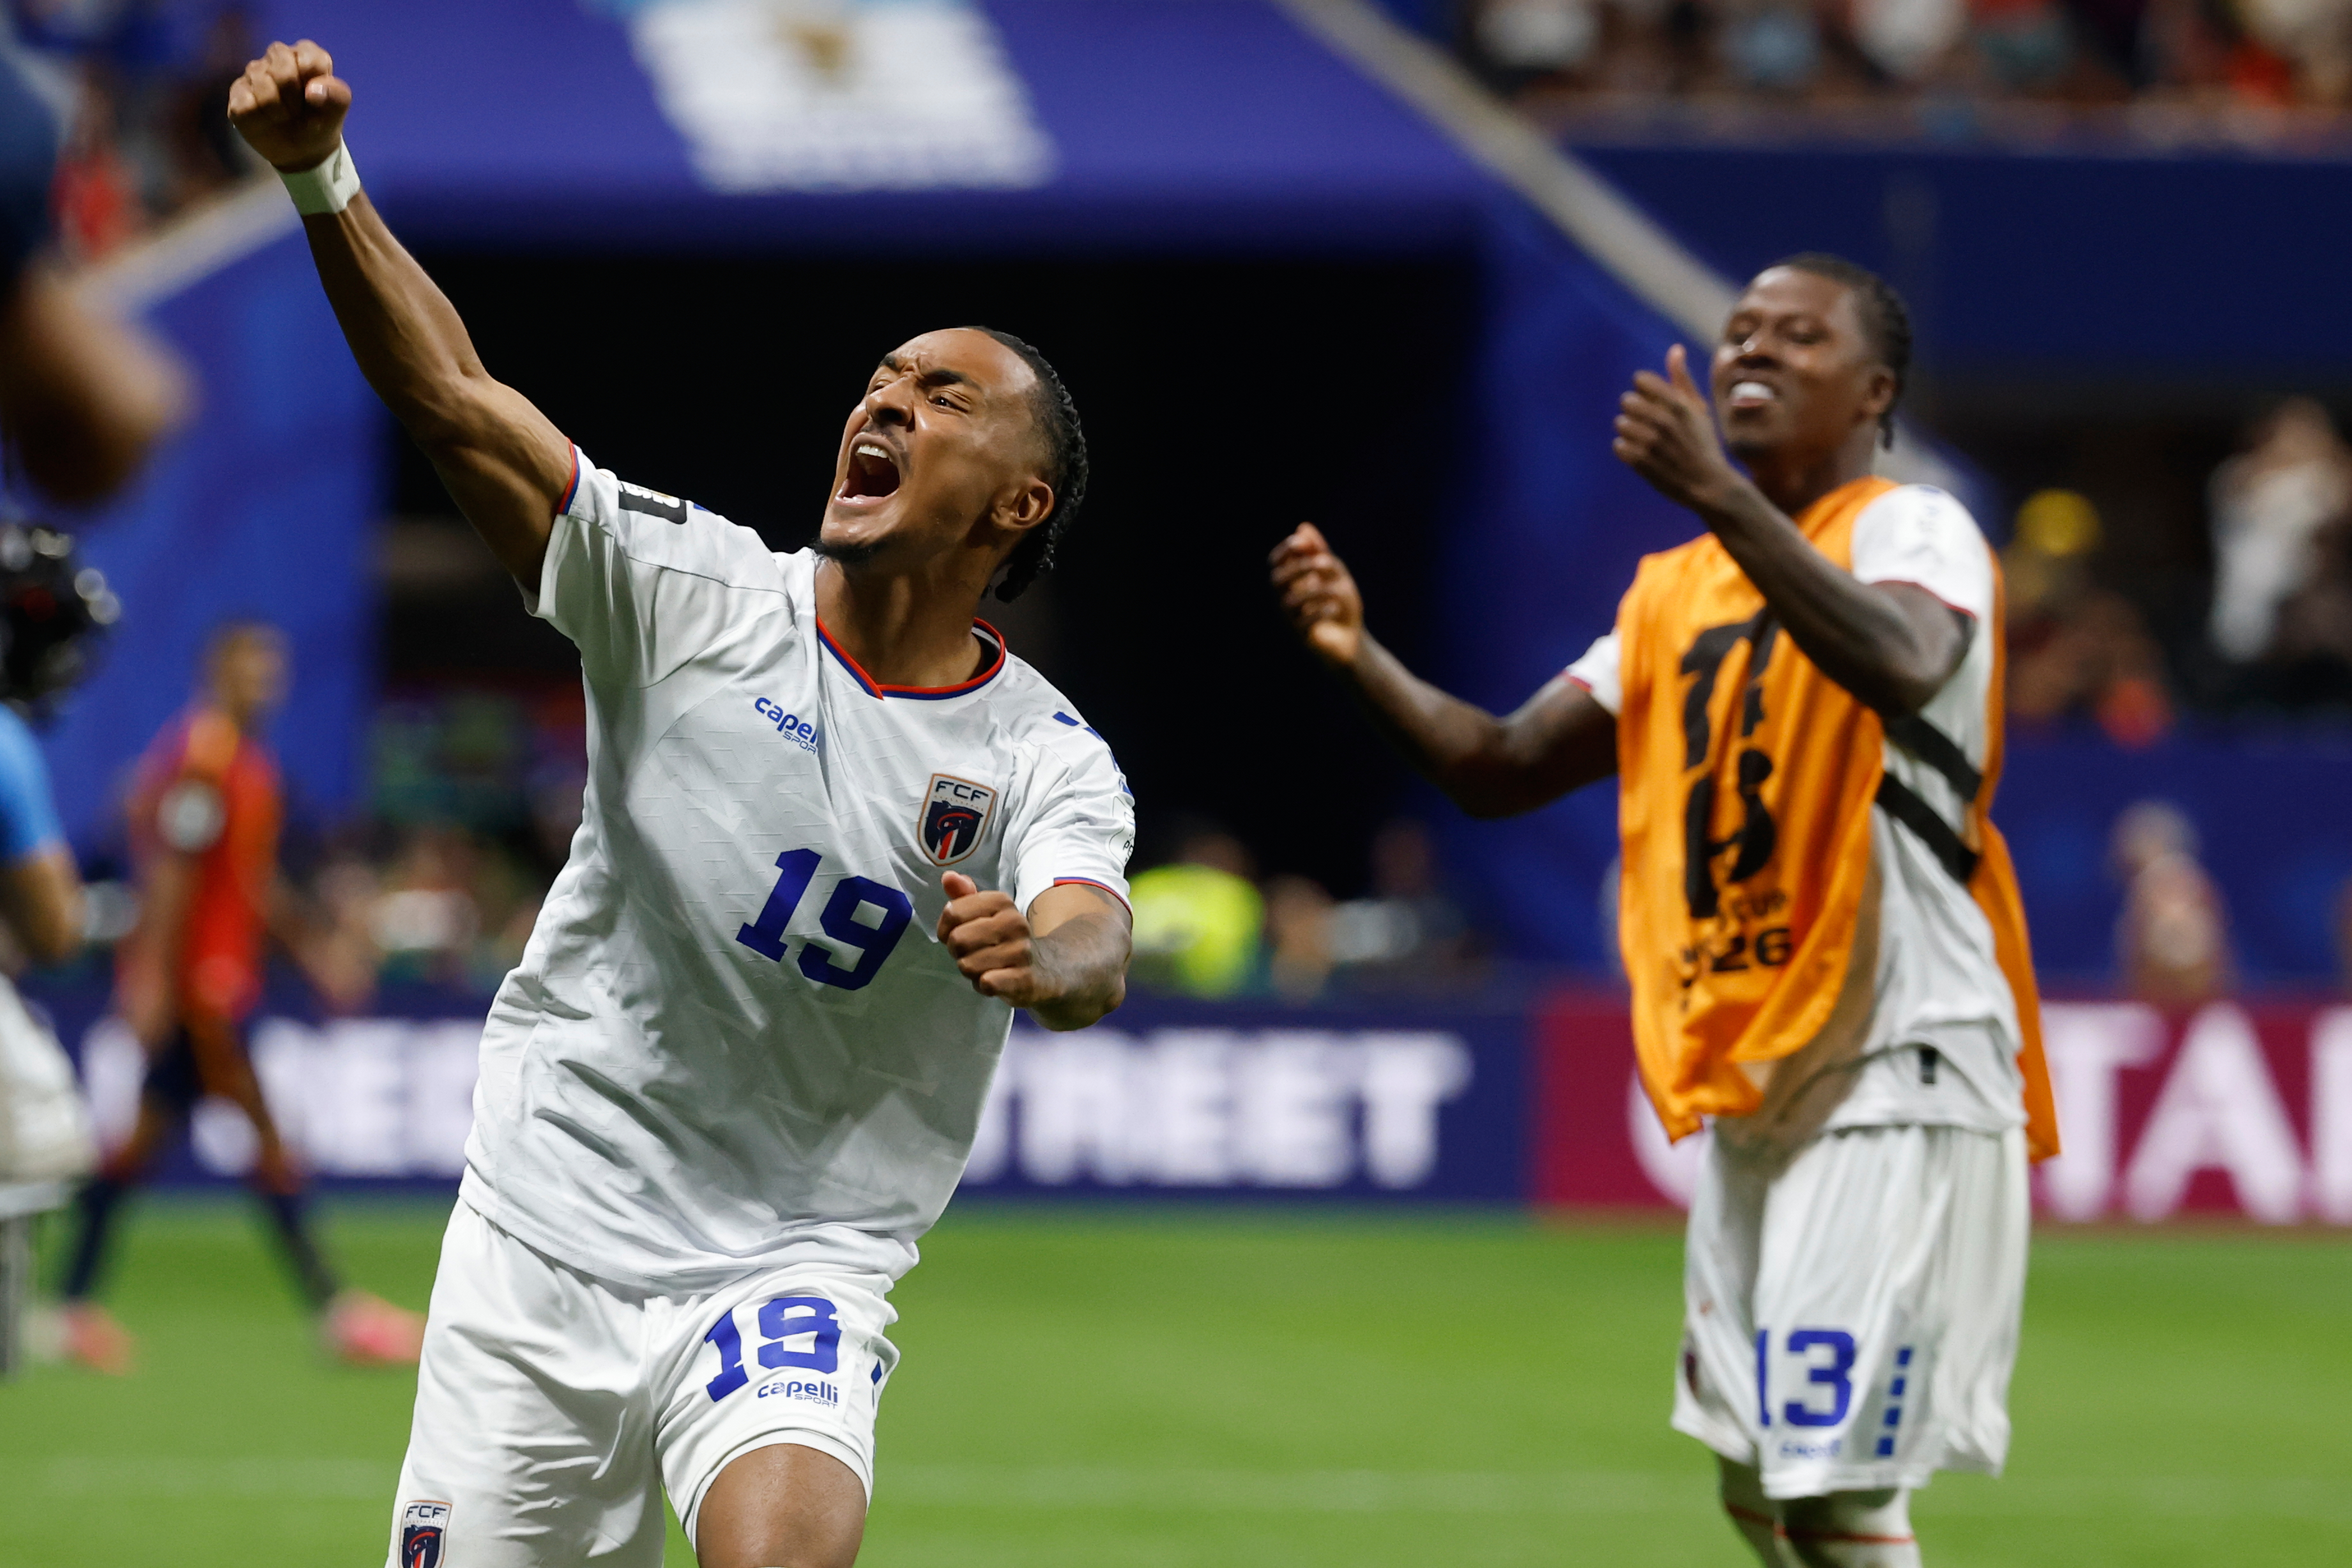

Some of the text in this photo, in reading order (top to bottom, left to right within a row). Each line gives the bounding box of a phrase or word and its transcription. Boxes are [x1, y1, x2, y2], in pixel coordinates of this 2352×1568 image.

[935, 780, 989, 801] FCF
[735, 848, 913, 991] 19
[704, 1297, 842, 1403] 19
[758, 1380, 838, 1403] capelli
[794, 1394, 838, 1409] SPORT
[406, 1505, 447, 1519] FCF
